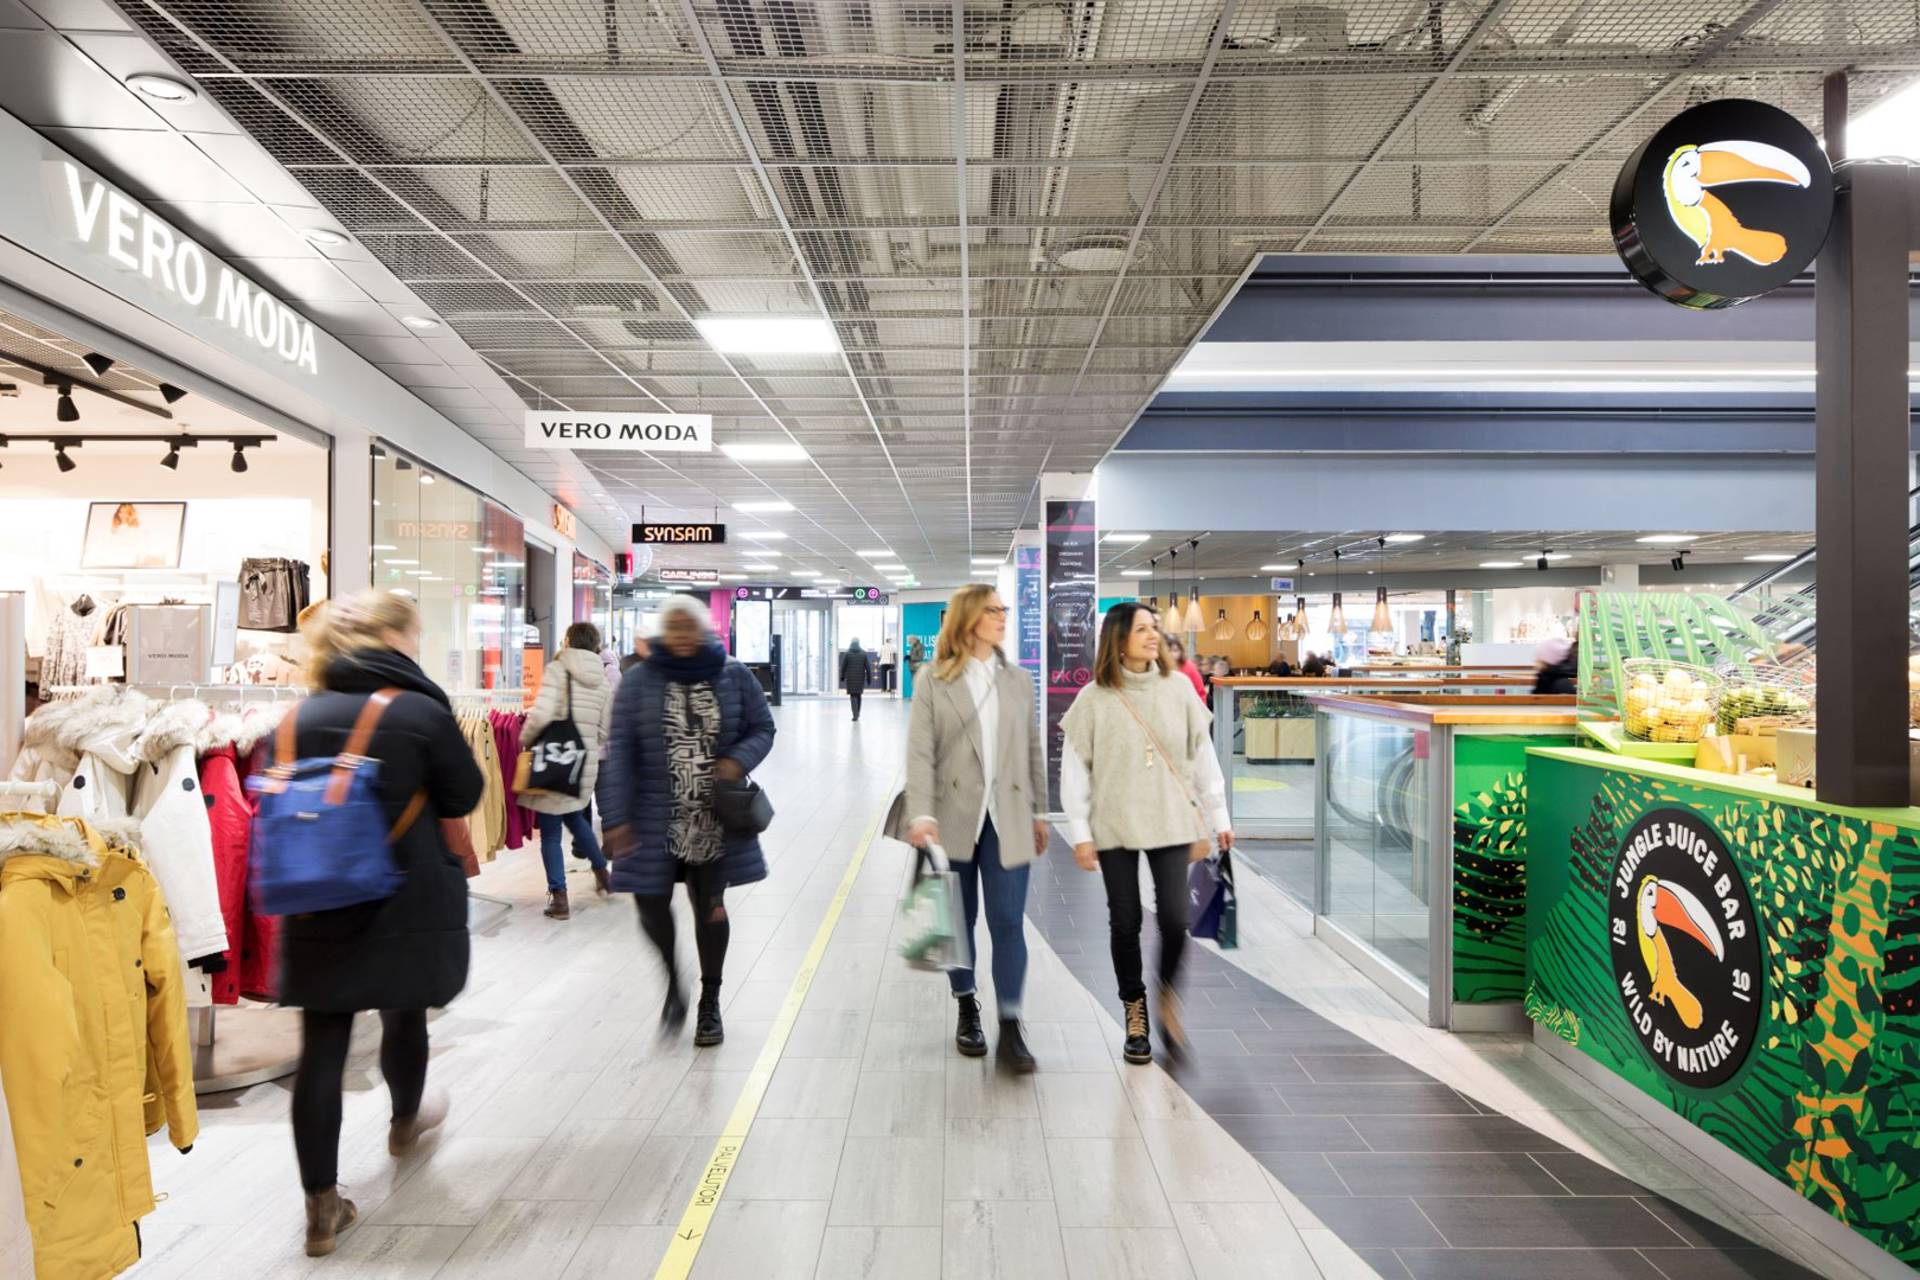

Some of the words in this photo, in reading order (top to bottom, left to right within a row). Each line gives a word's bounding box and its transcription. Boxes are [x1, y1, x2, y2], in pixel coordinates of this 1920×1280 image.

[65, 161, 206, 306] VERO
[215, 267, 318, 375] MODA
[541, 422, 611, 440] VERO
[619, 423, 698, 442] MODA
[644, 526, 712, 542] SYNSAM
[1616, 823, 1663, 899] JUNGLE
[1665, 822, 1718, 877] JUICE
[1714, 873, 1746, 941] BAR
[1613, 917, 1627, 937] 20
[1732, 968, 1751, 992] 10
[1621, 971, 1653, 1036] WILD
[1653, 1028, 1675, 1063] BY
[1677, 1019, 1740, 1074] NATURE
[695, 1145, 736, 1206] PALVELUTORI
